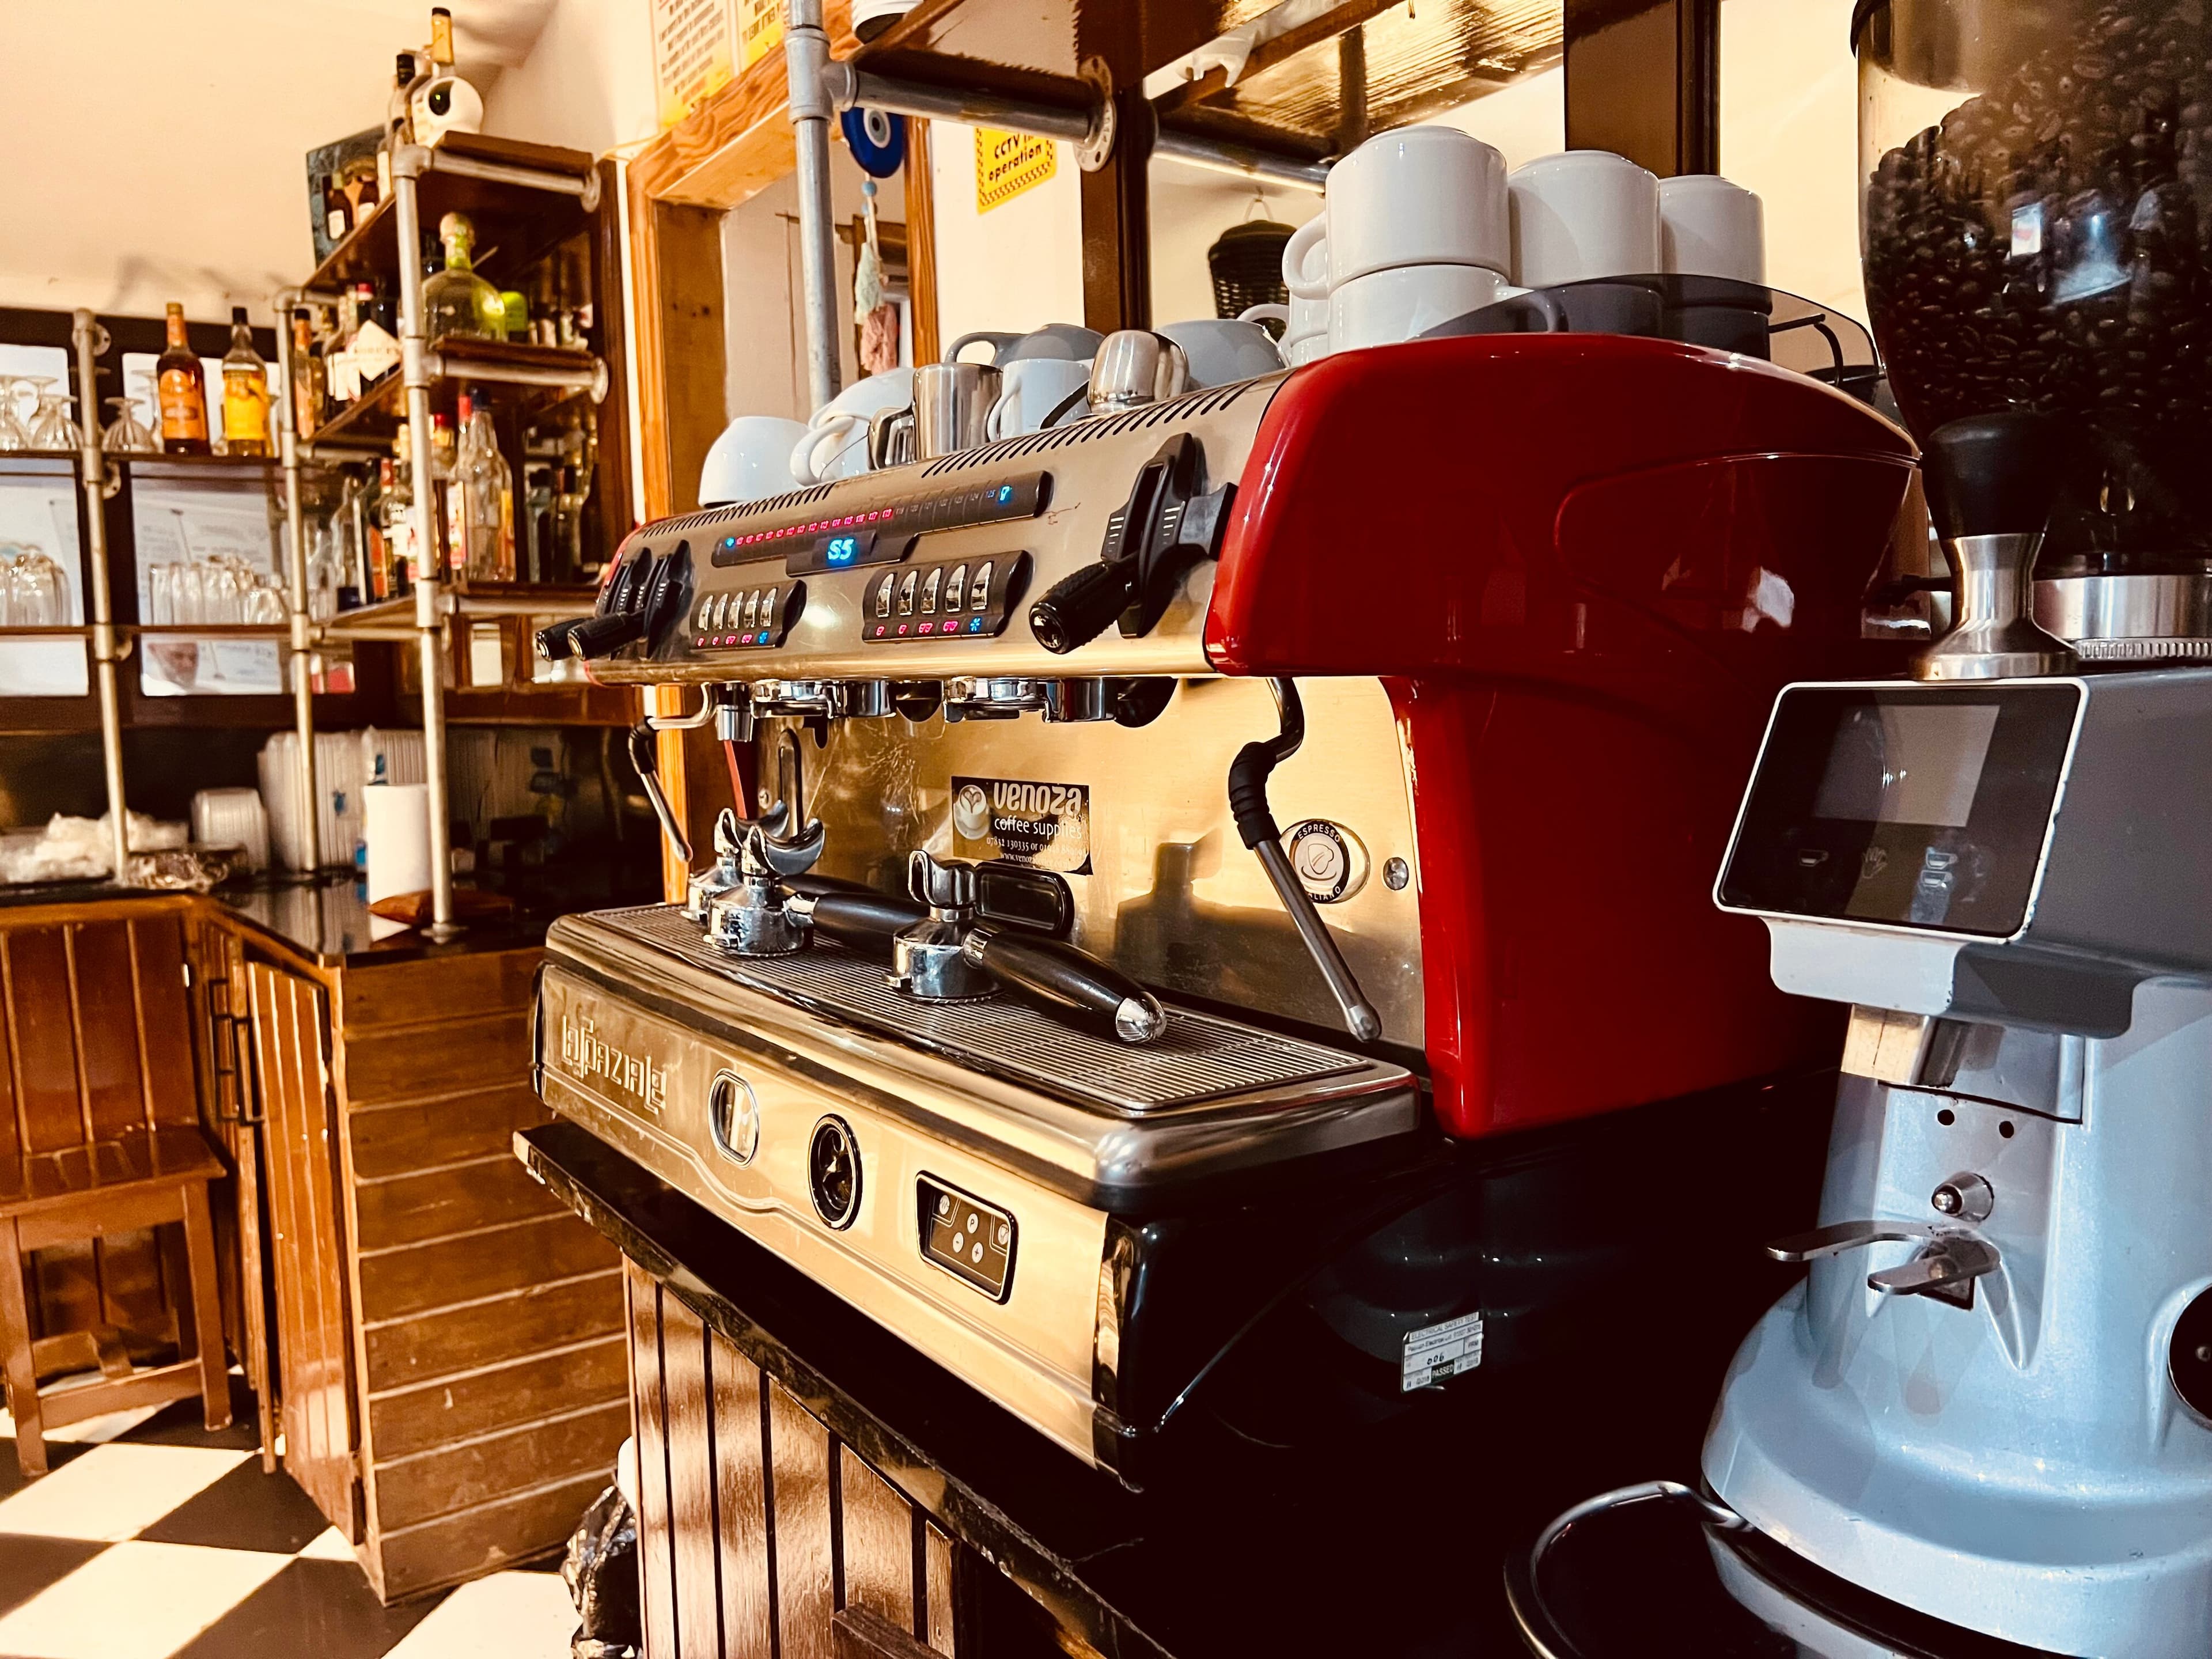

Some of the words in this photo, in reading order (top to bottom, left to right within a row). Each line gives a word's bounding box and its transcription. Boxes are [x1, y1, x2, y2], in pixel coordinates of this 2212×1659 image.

[995, 134, 1020, 159] CCTV
[989, 144, 1041, 182] operation
[828, 538, 854, 560] S5
[994, 782, 1082, 817] venoza
[995, 815, 1029, 833] coffee
[1033, 818, 1082, 841] supplies
[1298, 824, 1340, 843] ESPRESSO
[1007, 839, 1029, 852] 130335
[970, 1218, 975, 1228] P
[1411, 1324, 1443, 1340] ELECTRICAL
[1427, 1352, 1445, 1365] 006
[1431, 1364, 1455, 1379] PASSED
